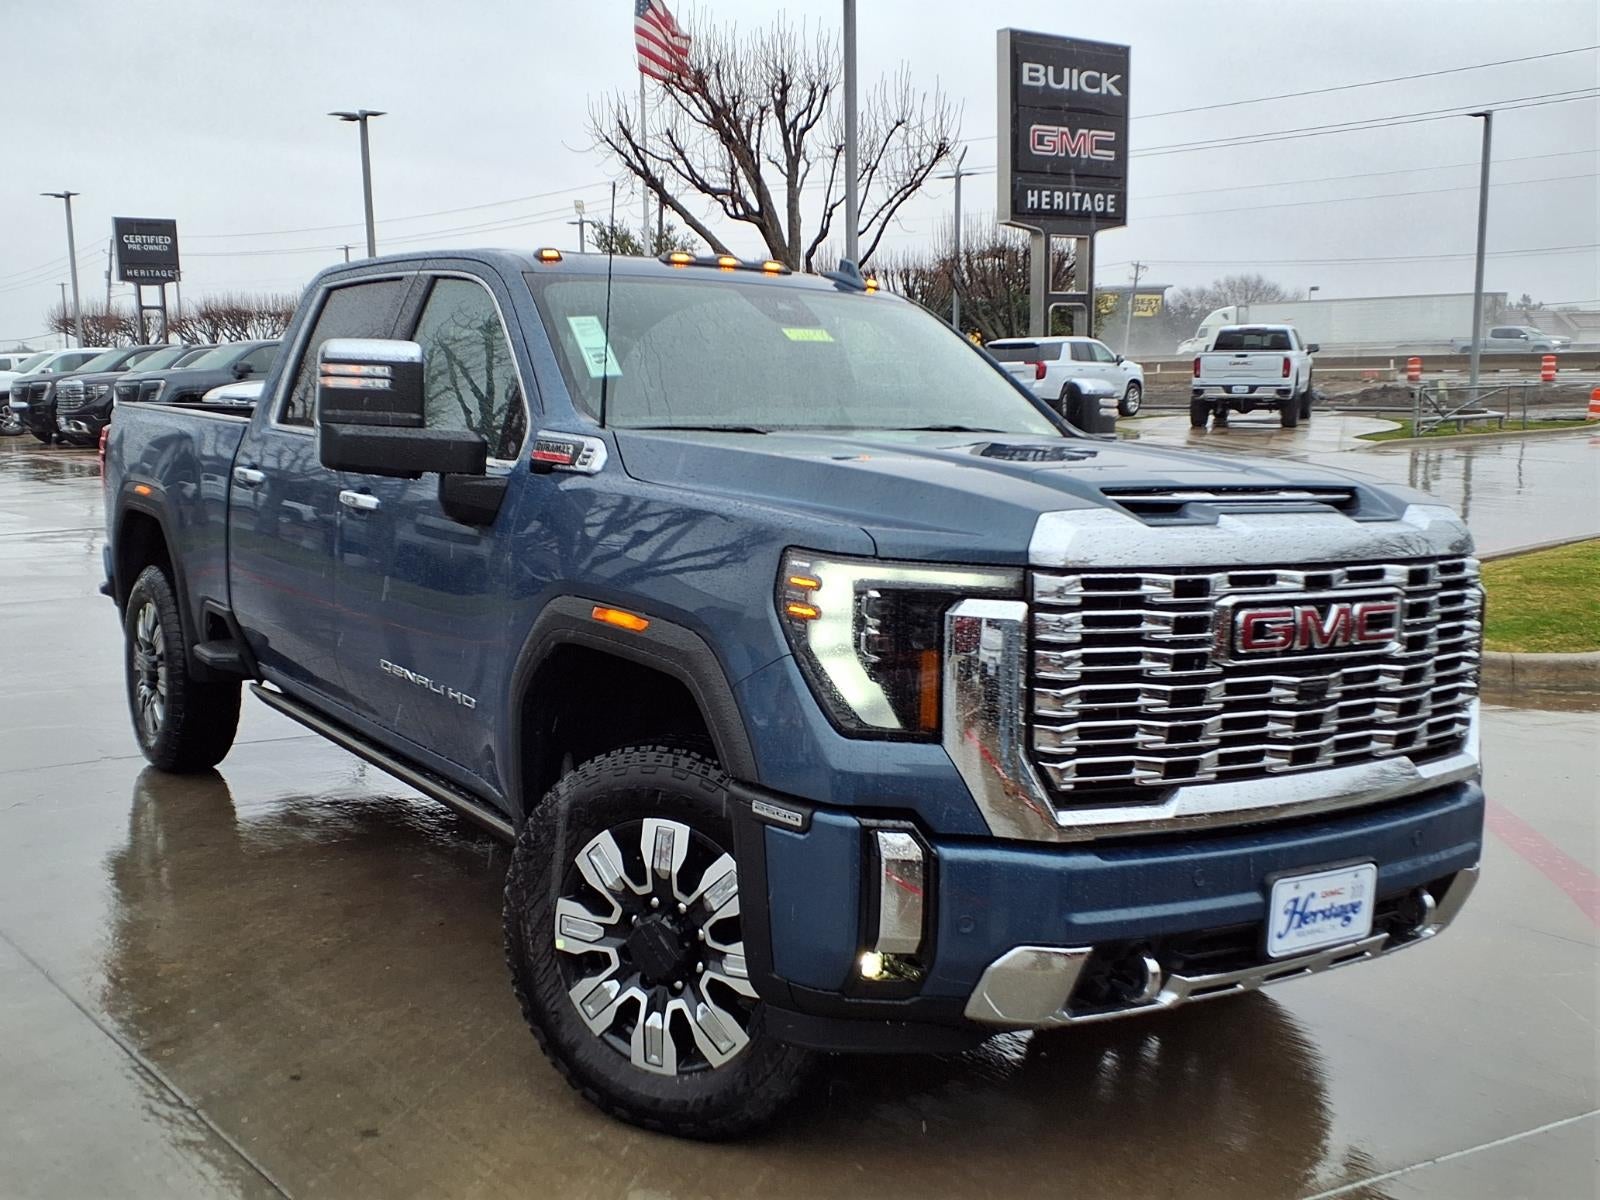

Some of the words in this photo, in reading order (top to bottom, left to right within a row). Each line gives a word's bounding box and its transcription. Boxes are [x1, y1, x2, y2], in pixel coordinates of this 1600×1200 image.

[1022, 62, 1122, 96] BUICK
[1030, 124, 1116, 161] GMC
[1027, 189, 1116, 213] HERITAGE
[122, 234, 172, 245] CERTIFIED
[127, 244, 169, 252] PRE-OWNED
[126, 268, 176, 278] HERITAGE
[1235, 602, 1398, 653] GMC
[379, 658, 445, 696] DENALI
[447, 687, 477, 710] HD
[1276, 891, 1363, 940] Heritage
